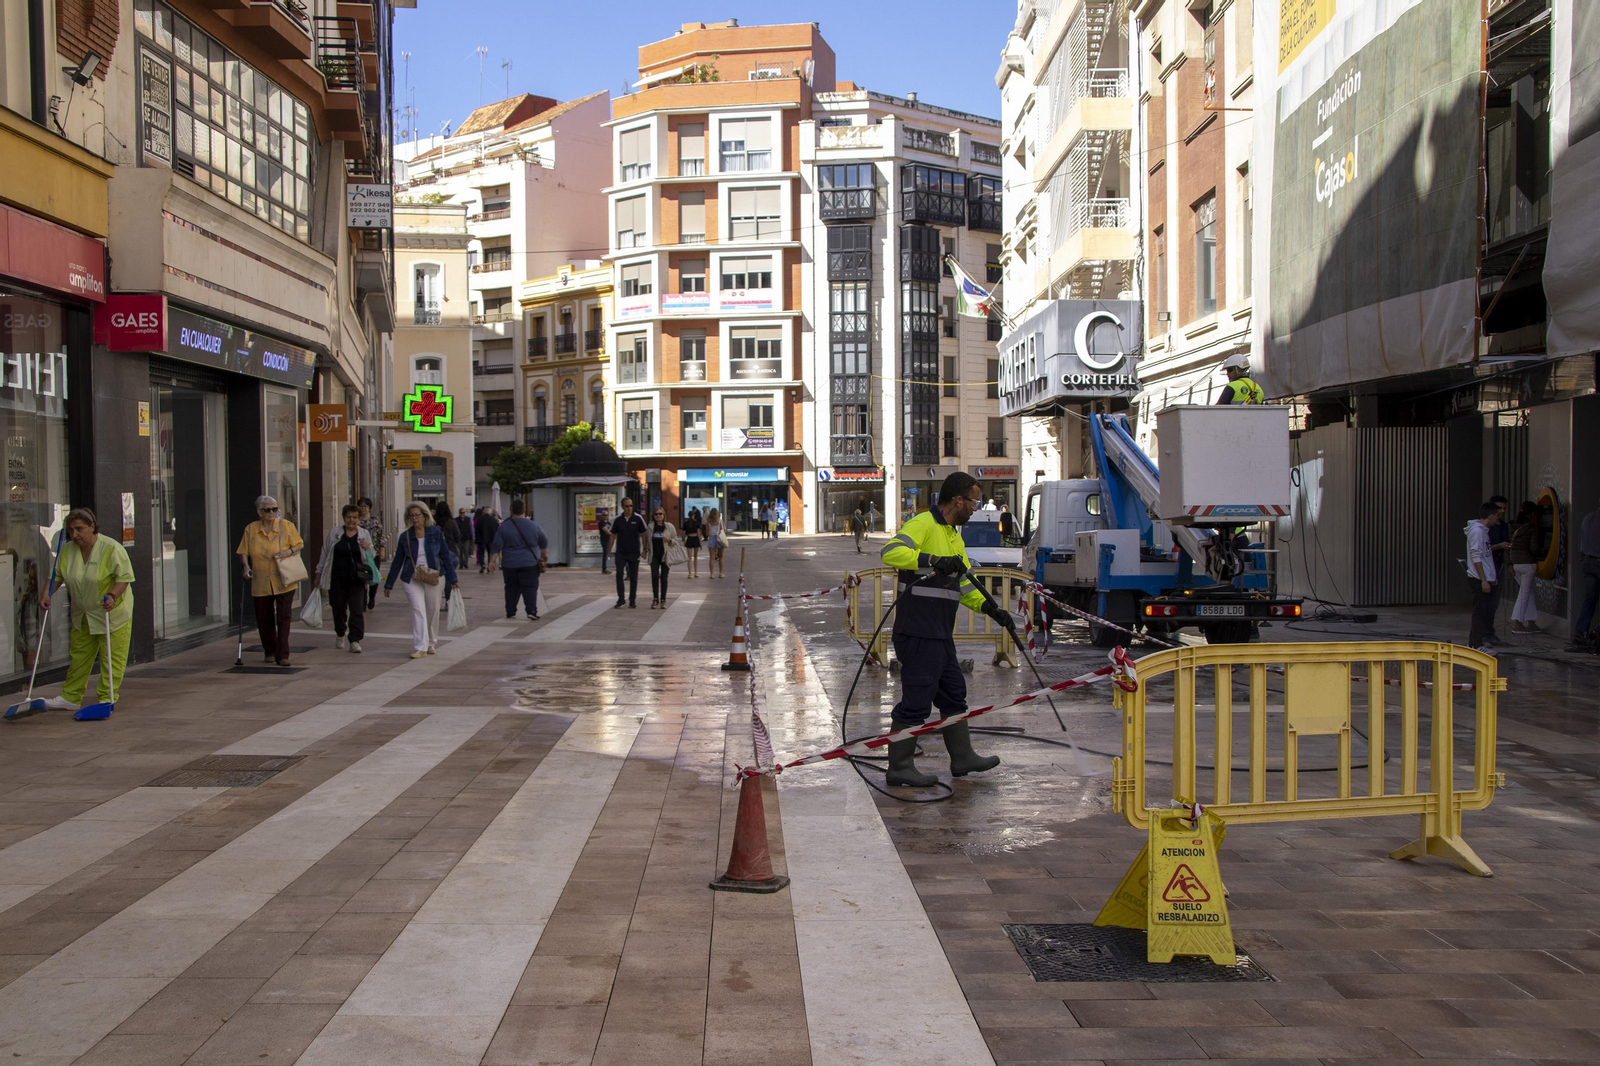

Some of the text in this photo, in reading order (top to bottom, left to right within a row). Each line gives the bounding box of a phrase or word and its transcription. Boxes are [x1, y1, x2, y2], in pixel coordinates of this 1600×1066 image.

[1280, 16, 1293, 41] PARA
[1280, 10, 1317, 63] DE LA CULTURA
[143, 56, 169, 85] SE VENDE
[1317, 68, 1361, 126] Fundación
[144, 105, 151, 123] SE
[1315, 134, 1359, 208] Cajasol
[366, 188, 390, 198] ikesa
[69, 272, 103, 295] amplifon
[111, 312, 159, 328] GAES
[180, 327, 190, 347] EN
[190, 330, 222, 355] CUALQUIER
[1074, 310, 1125, 370] C
[1061, 373, 1136, 385] CORTEFIEL
[417, 477, 442, 486] DIONI
[1202, 606, 1244, 615] 8588 LDG
[1161, 848, 1205, 857] ATENCION
[1173, 903, 1202, 911] SUELO
[1158, 912, 1220, 922] RESBALADIZO
